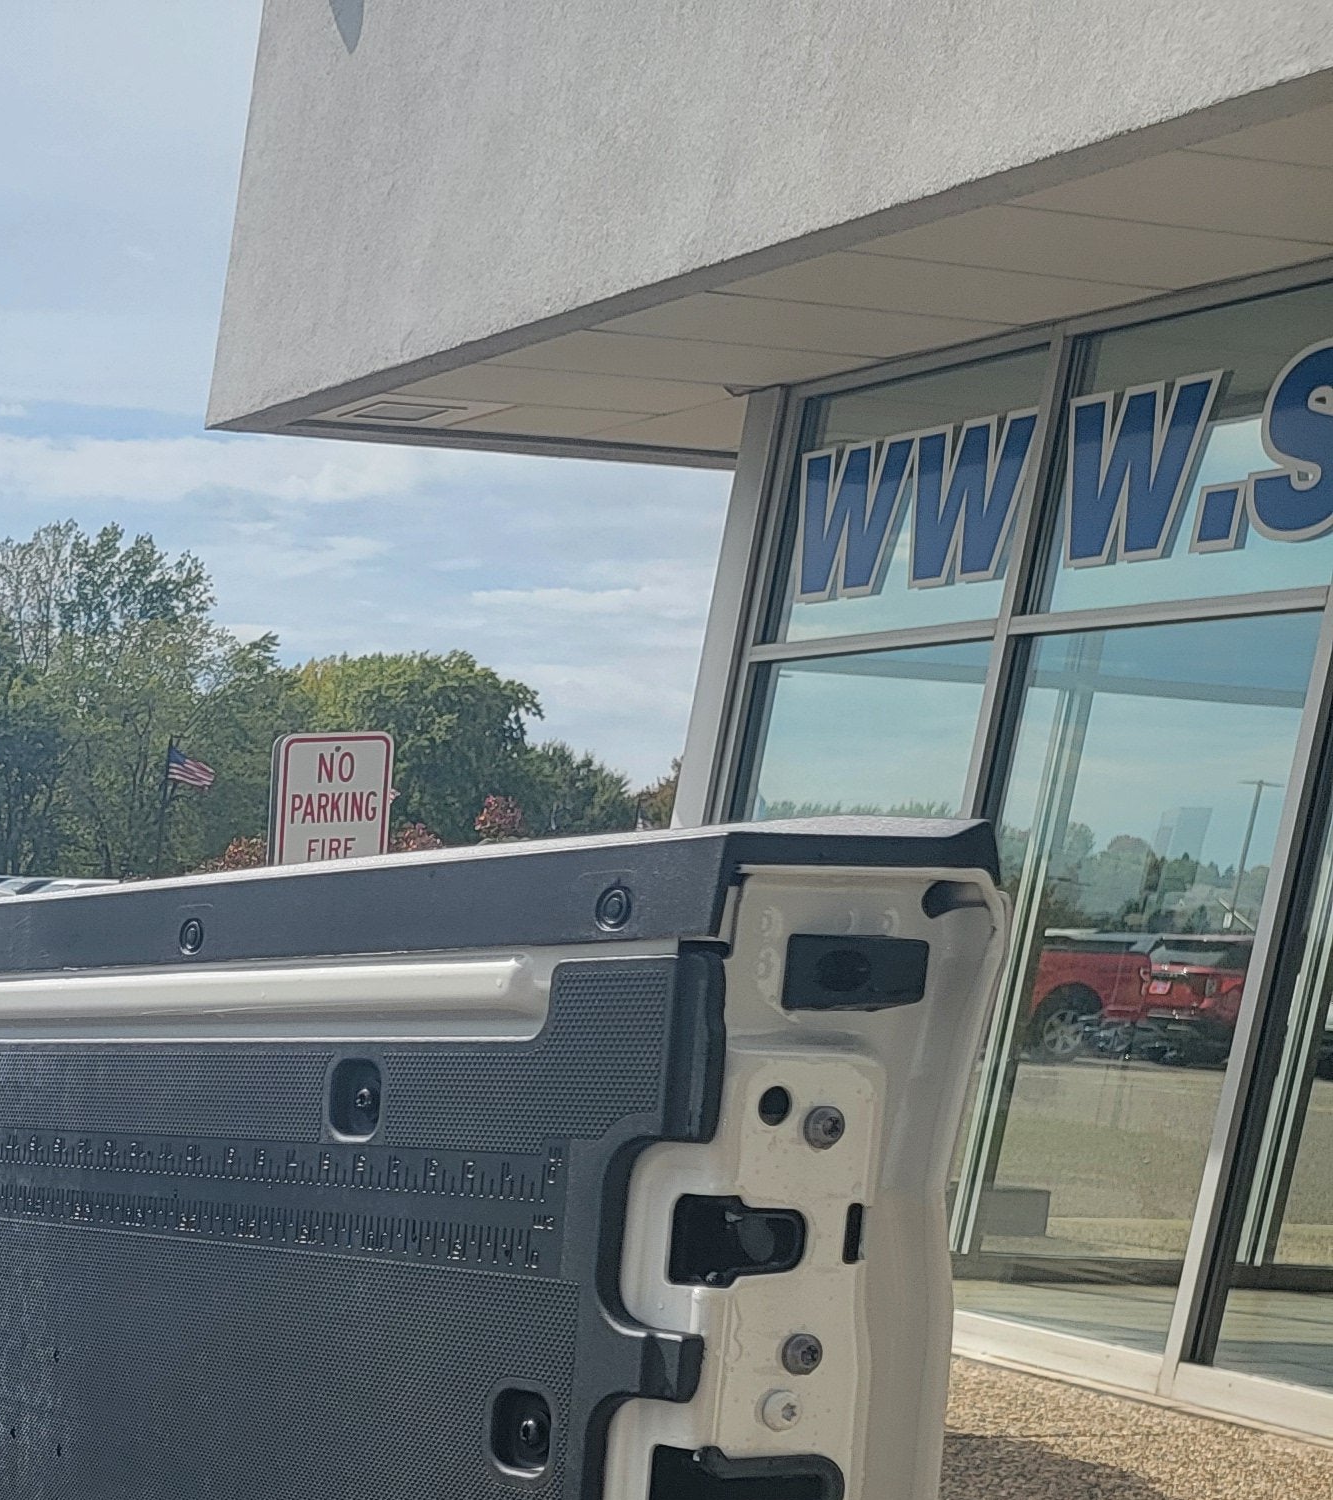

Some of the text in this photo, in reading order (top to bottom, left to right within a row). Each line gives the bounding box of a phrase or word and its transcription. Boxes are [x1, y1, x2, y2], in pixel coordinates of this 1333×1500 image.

[317, 752, 355, 783] NO
[290, 791, 378, 824] PARKING
[307, 838, 356, 861] FIRE
